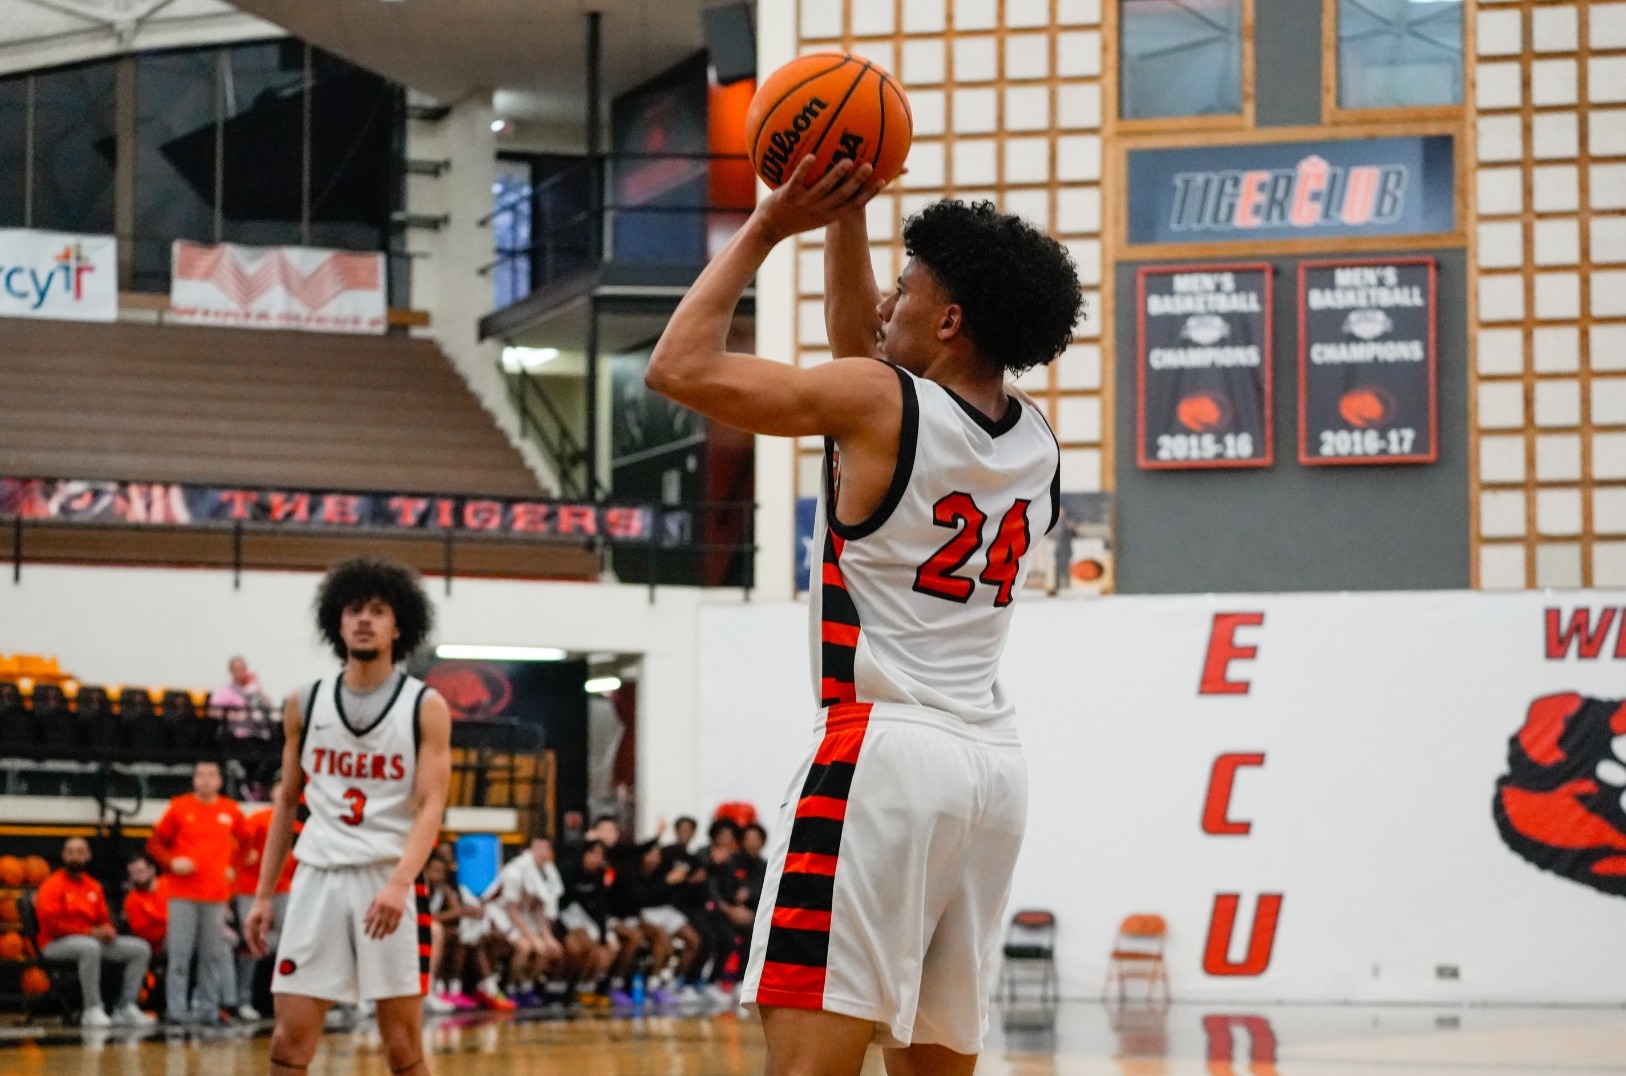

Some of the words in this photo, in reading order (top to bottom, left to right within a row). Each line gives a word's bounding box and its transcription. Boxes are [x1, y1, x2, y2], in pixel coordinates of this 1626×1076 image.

[761, 97, 829, 185] Wilson
[1173, 272, 1235, 293] MEN'S
[1334, 266, 1398, 287] MEN'S
[1147, 291, 1260, 316] BASKETBALL
[1308, 285, 1424, 310] BASKETBALL
[1149, 346, 1260, 370] CHAMPIONS
[1310, 340, 1424, 365] CHAMPIONS
[1157, 432, 1254, 460] 2015-16
[1319, 428, 1416, 456] 2016-17
[220, 491, 359, 525] THE
[389, 497, 644, 538] TIGERS
[912, 490, 1031, 608] 24
[312, 747, 405, 780] TIGERS
[340, 787, 367, 827] 3
